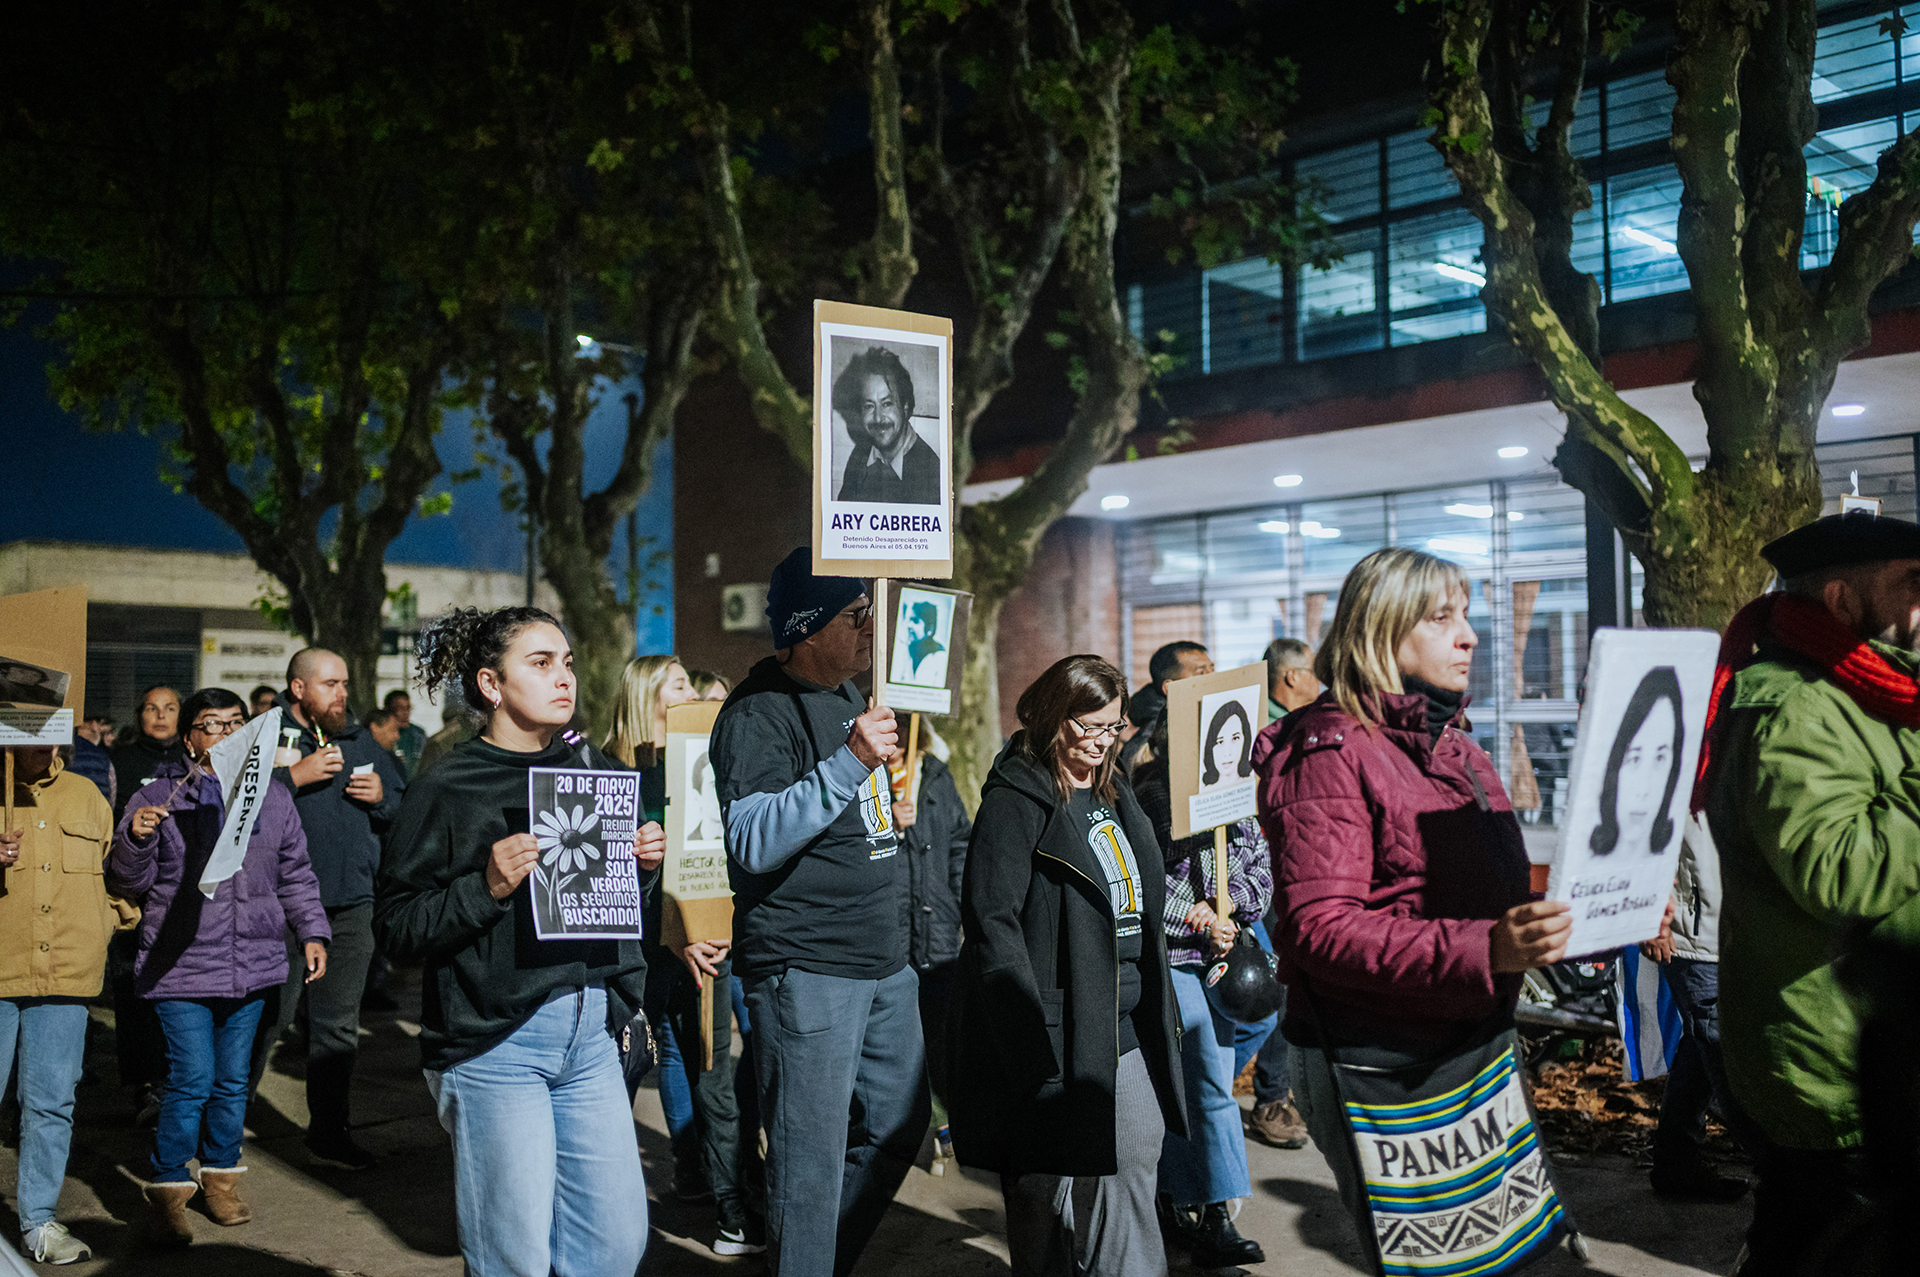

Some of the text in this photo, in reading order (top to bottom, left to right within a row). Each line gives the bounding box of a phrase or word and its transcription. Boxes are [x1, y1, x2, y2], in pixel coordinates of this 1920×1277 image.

[831, 513, 942, 532] ARY CABRERA
[843, 535, 874, 543] Detenido
[875, 535, 919, 545] Desaparecido
[894, 543, 929, 551] 05.04.1976
[557, 775, 635, 795] 20 DE MAYO
[234, 745, 260, 847] PRESENTE
[594, 793, 634, 816] 2025
[601, 819, 635, 831] TREINTA
[601, 831, 636, 841] MARCHAS
[606, 841, 634, 860] UNA
[605, 861, 636, 877] SOLA
[589, 877, 638, 893] VERDAD
[557, 892, 638, 907] LOS SEGUIMOS
[563, 907, 639, 926] BUSCANDO!
